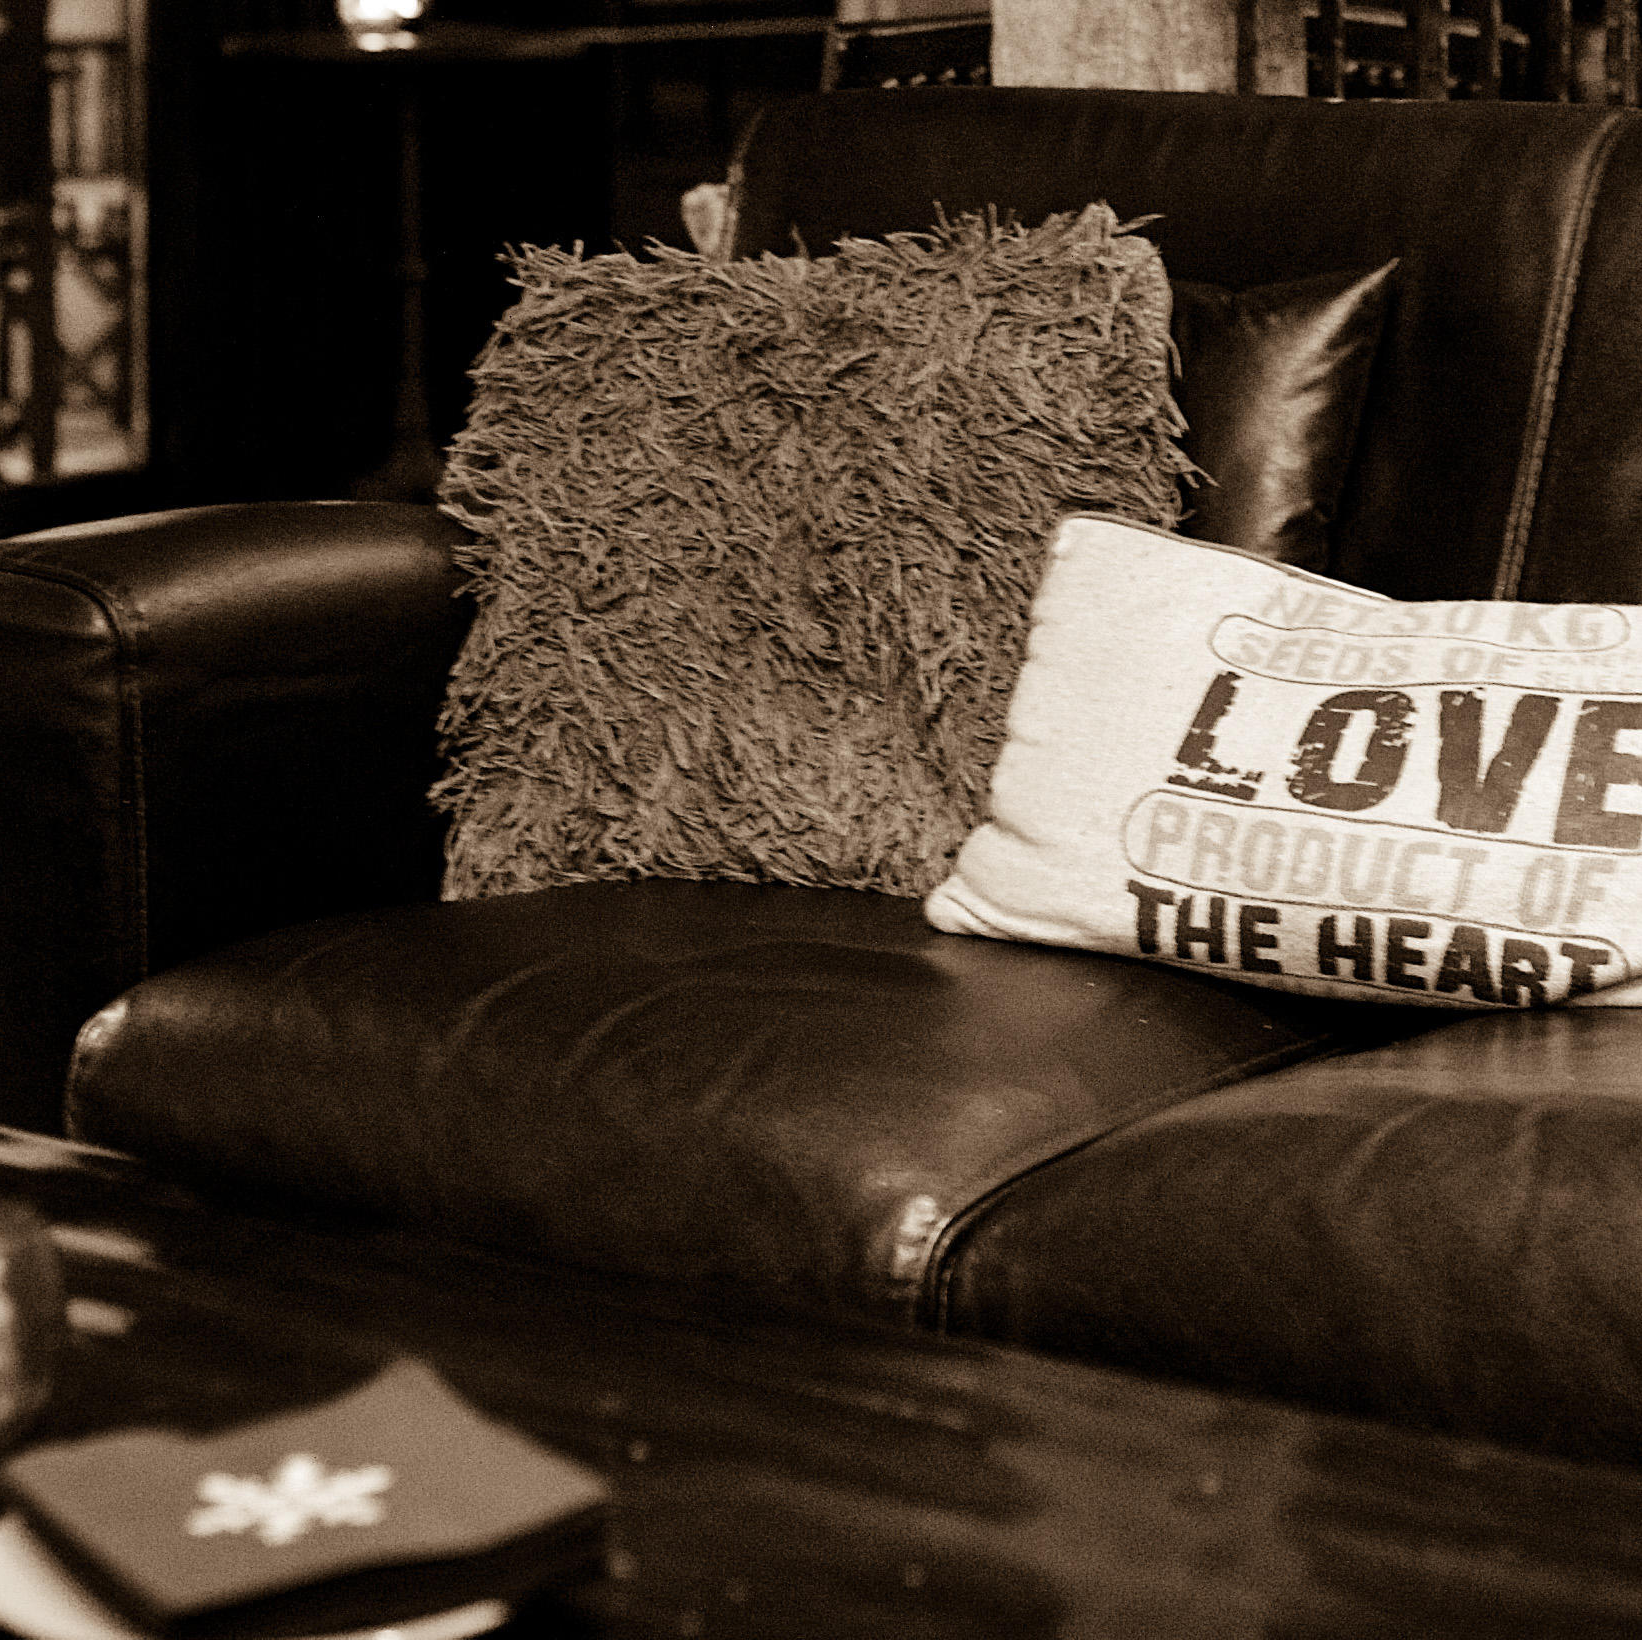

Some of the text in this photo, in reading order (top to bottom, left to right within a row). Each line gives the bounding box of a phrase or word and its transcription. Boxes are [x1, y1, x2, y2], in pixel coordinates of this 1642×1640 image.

[1238, 631, 1524, 682] SEEDS OF
[1145, 801, 1619, 929] PRODUCT OF
[1127, 878, 1613, 1007] THE HEART
